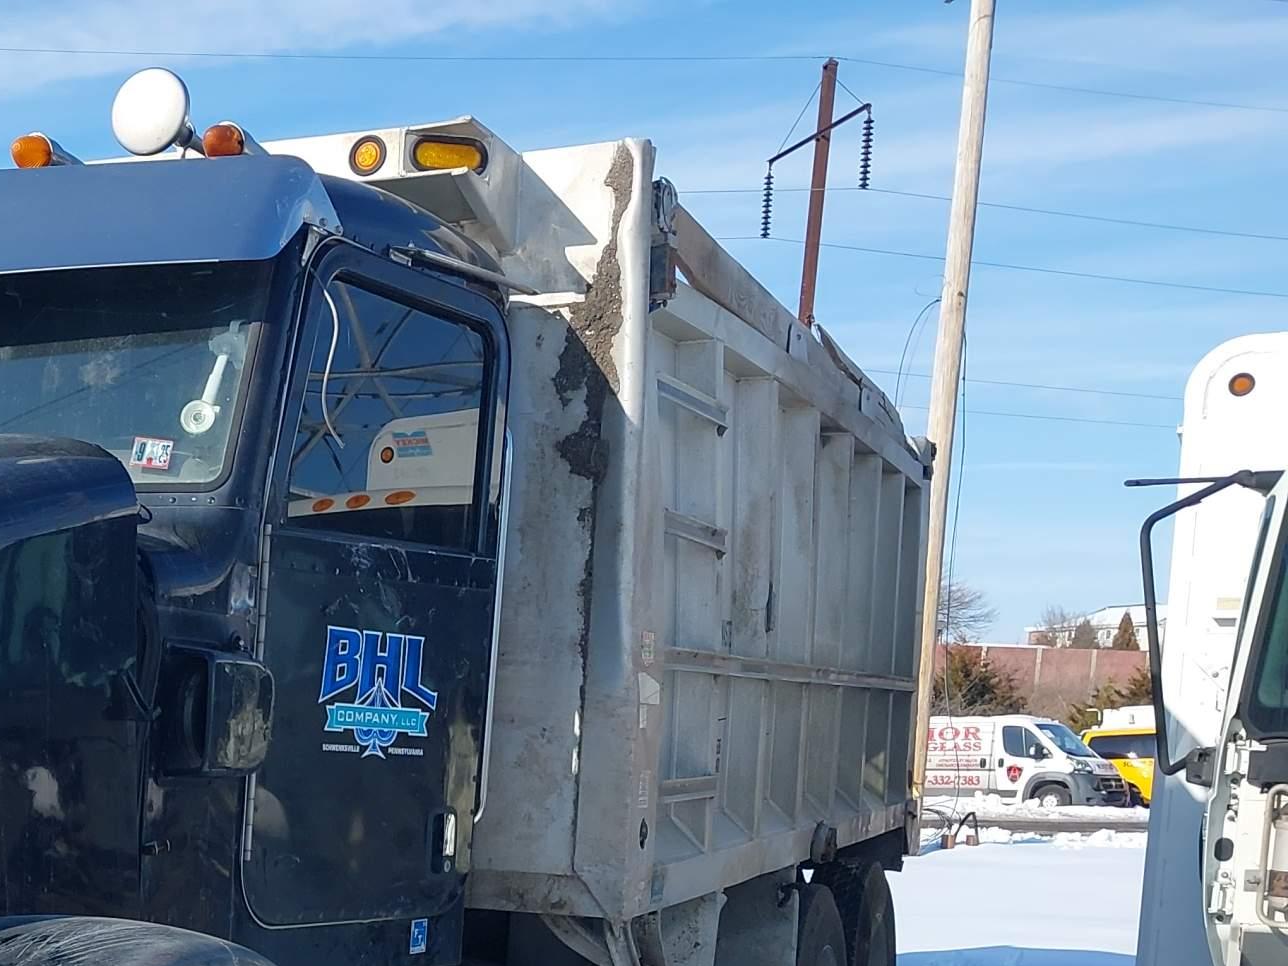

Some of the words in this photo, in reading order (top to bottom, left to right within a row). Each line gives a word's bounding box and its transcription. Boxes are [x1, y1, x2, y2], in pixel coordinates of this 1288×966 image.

[318, 625, 438, 711] BHL
[337, 710, 399, 725] COMPANY,
[401, 717, 417, 726] LLC
[928, 741, 982, 752] GLASS
[925, 775, 981, 786] -332-7383
